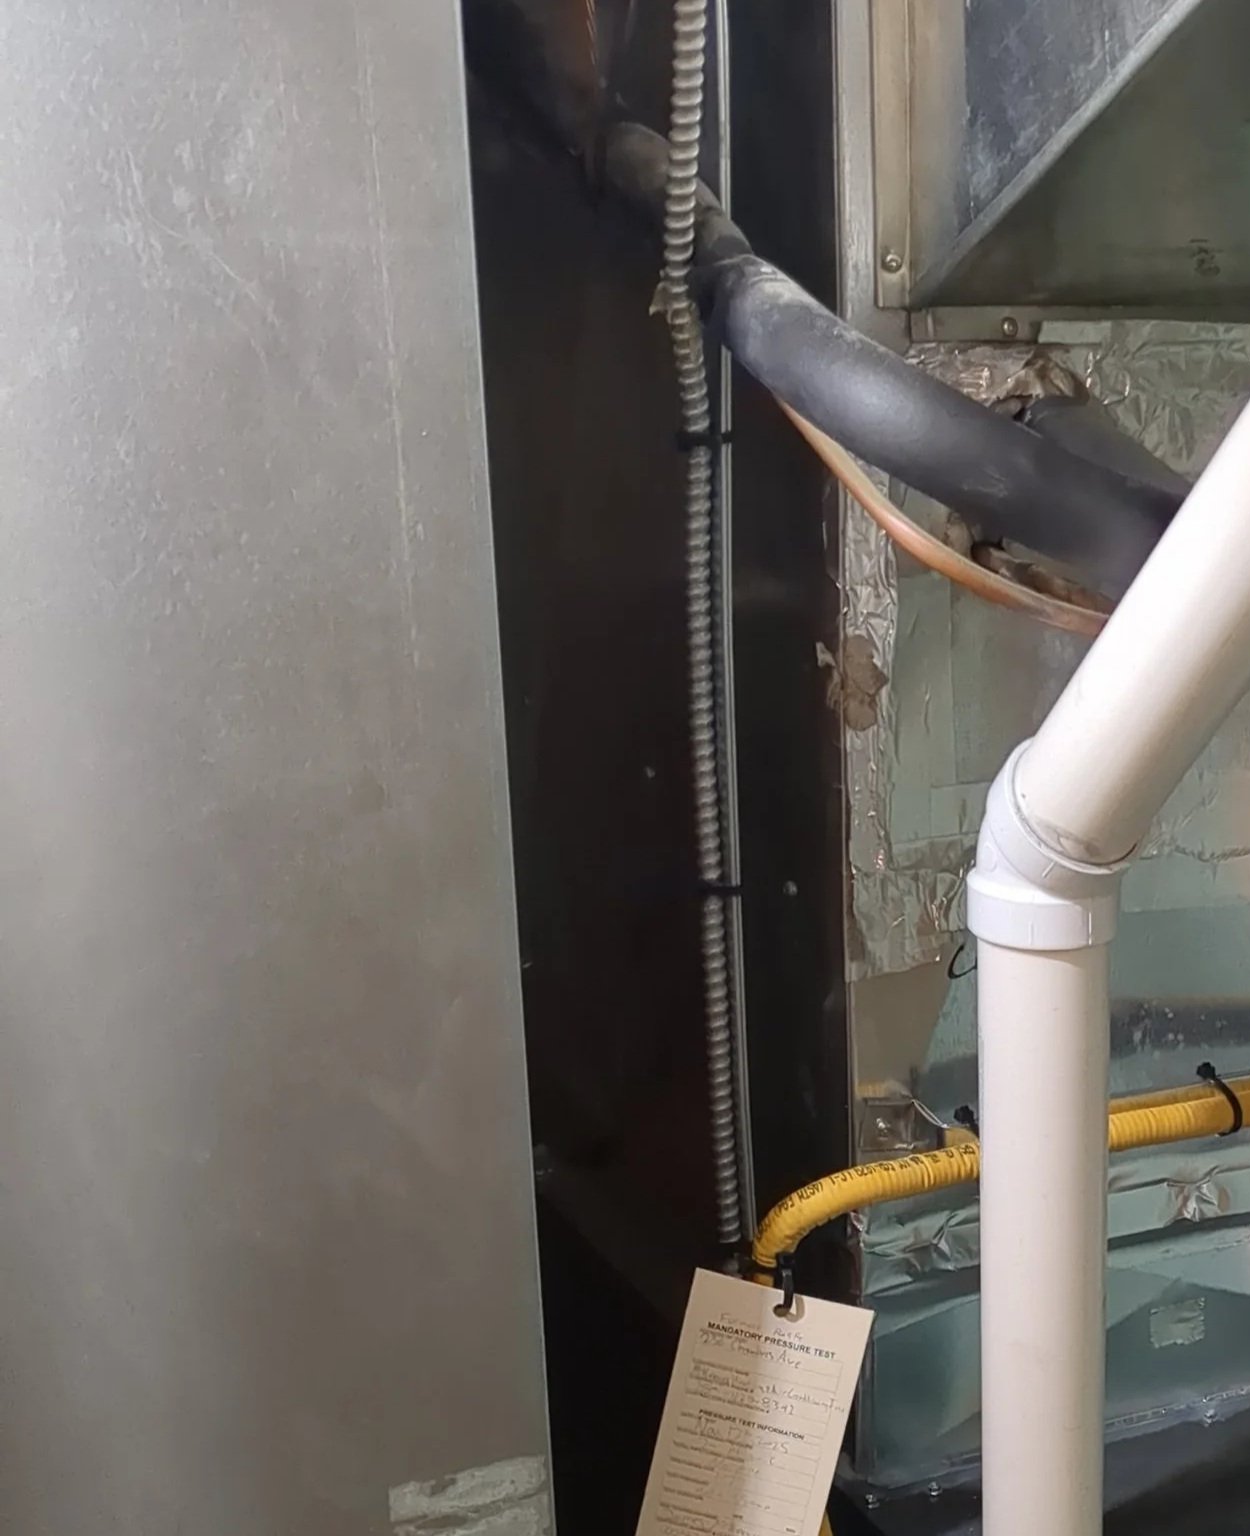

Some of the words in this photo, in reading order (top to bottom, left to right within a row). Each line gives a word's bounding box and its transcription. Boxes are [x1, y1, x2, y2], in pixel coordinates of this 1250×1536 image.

[707, 1321, 764, 1342] MANDATORY
[763, 1336, 812, 1354] PRESSURE
[813, 1347, 837, 1360] TEST
[756, 1423, 806, 1441] INFORMATION
